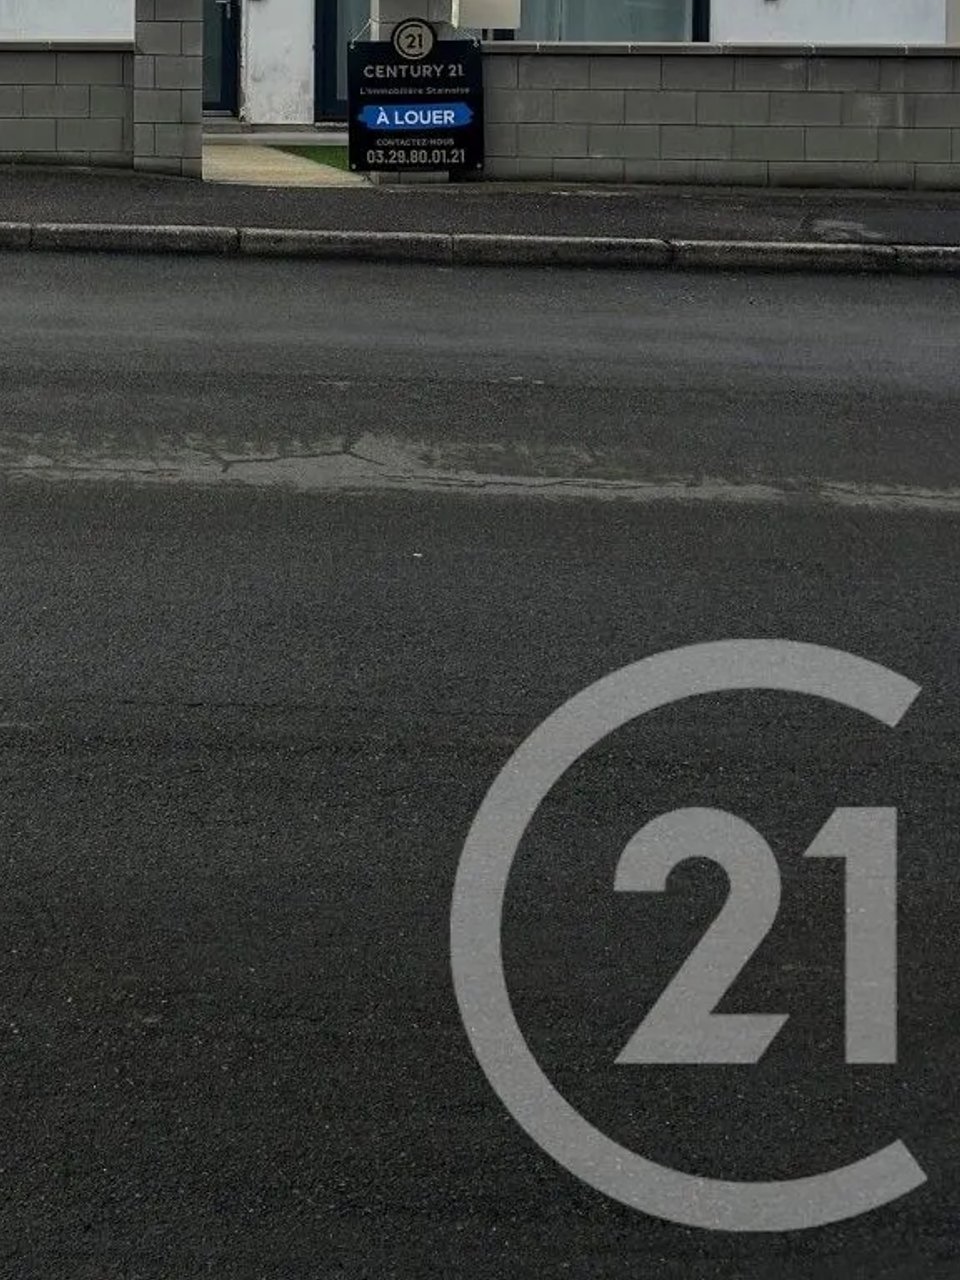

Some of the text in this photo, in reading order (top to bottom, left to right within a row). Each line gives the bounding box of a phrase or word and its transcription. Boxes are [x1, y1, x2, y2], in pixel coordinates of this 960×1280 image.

[405, 33, 423, 49] 21
[363, 63, 465, 78] CENTURY 21
[376, 106, 455, 125] À LOUER
[366, 148, 465, 163] 03.29.80.01.21
